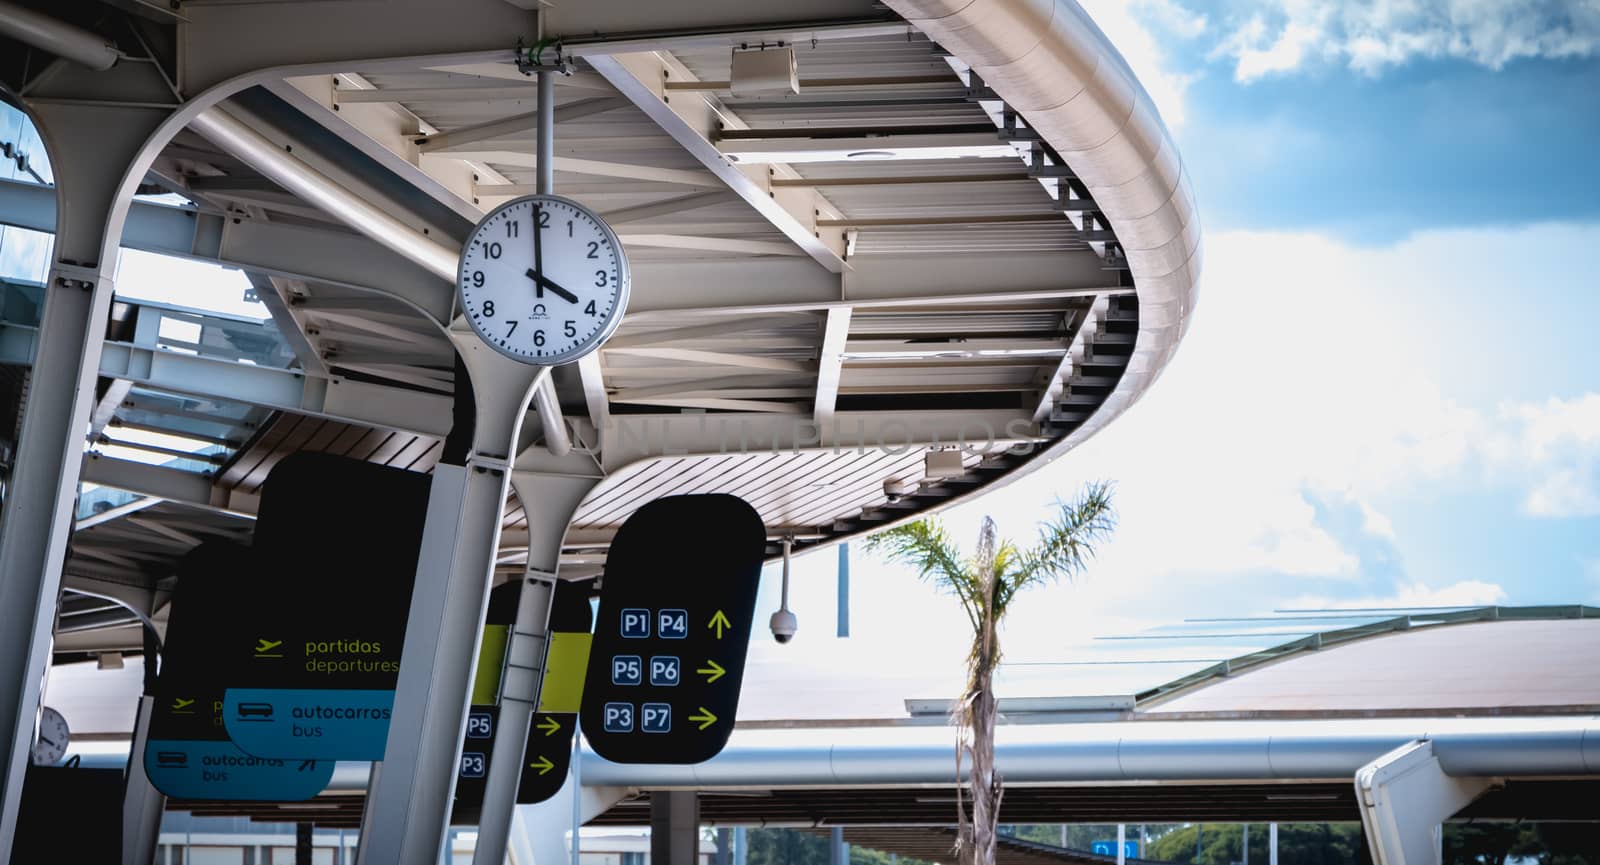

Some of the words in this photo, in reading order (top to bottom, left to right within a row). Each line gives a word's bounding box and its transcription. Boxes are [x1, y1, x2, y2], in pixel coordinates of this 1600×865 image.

[505, 220, 518, 238] 11
[567, 220, 573, 238] 1
[482, 242, 502, 260] 10
[587, 242, 599, 259] 2
[473, 271, 485, 288] 9
[595, 270, 607, 287] 3
[483, 300, 495, 317] 8
[584, 300, 597, 317] 4
[506, 321, 518, 338] 7
[565, 321, 577, 338] 5
[534, 330, 545, 347] 6
[625, 614, 646, 632] P1
[660, 615, 685, 633] P4
[305, 639, 382, 656] partidas
[305, 658, 399, 674] departures
[614, 661, 639, 679] P5
[652, 662, 677, 680] P6
[292, 704, 391, 719] autocarros
[606, 708, 631, 727] P3
[644, 709, 669, 727] P7
[292, 723, 323, 737] bus
[469, 718, 490, 733] P5
[462, 757, 483, 772] P3
[202, 770, 228, 782] bus
